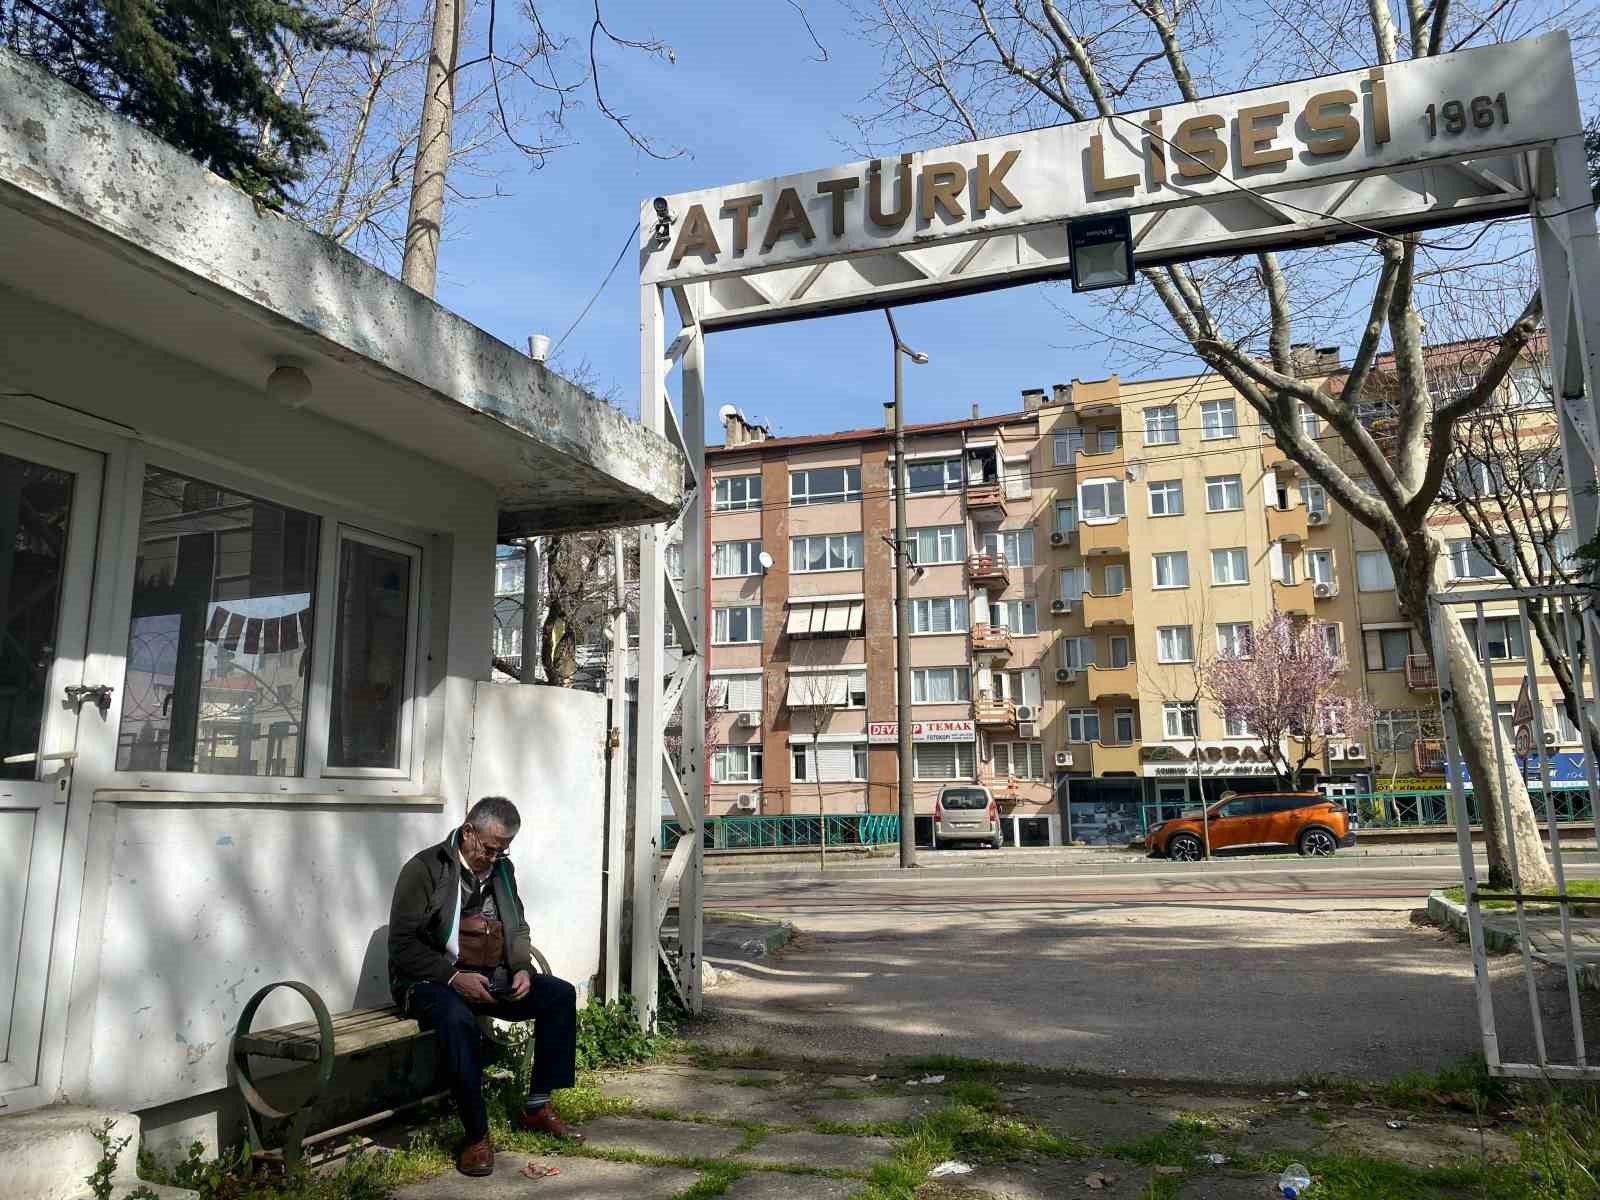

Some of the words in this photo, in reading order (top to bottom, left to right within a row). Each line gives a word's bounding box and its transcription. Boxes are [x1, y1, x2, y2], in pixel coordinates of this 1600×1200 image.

[1424, 92, 1508, 137] 1961
[669, 151, 1022, 267] ATATÜRK
[1087, 67, 1390, 192] LİSESİ
[872, 724, 919, 735] DEVEP
[928, 722, 972, 731] TEMAK
